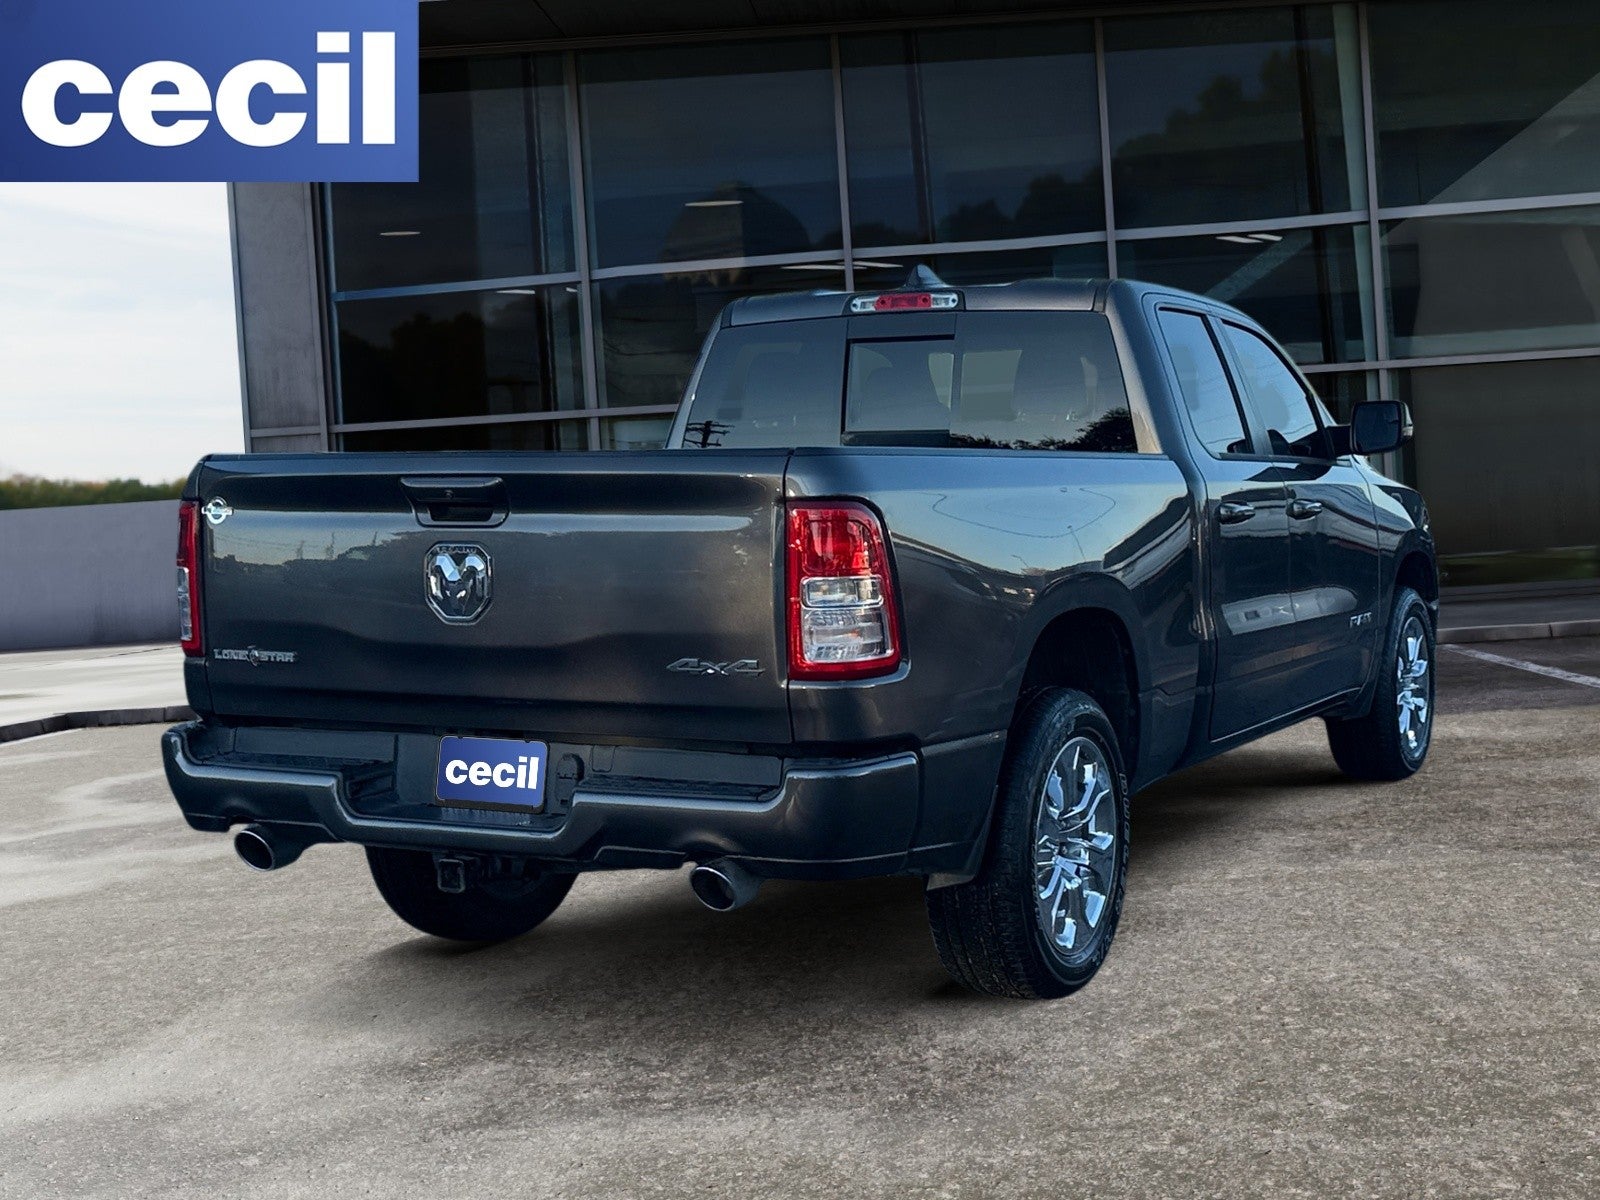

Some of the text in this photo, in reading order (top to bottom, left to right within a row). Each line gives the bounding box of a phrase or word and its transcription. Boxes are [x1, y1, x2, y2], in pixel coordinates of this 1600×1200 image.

[213, 648, 295, 663] LONE STAR
[445, 755, 540, 790] cecil
